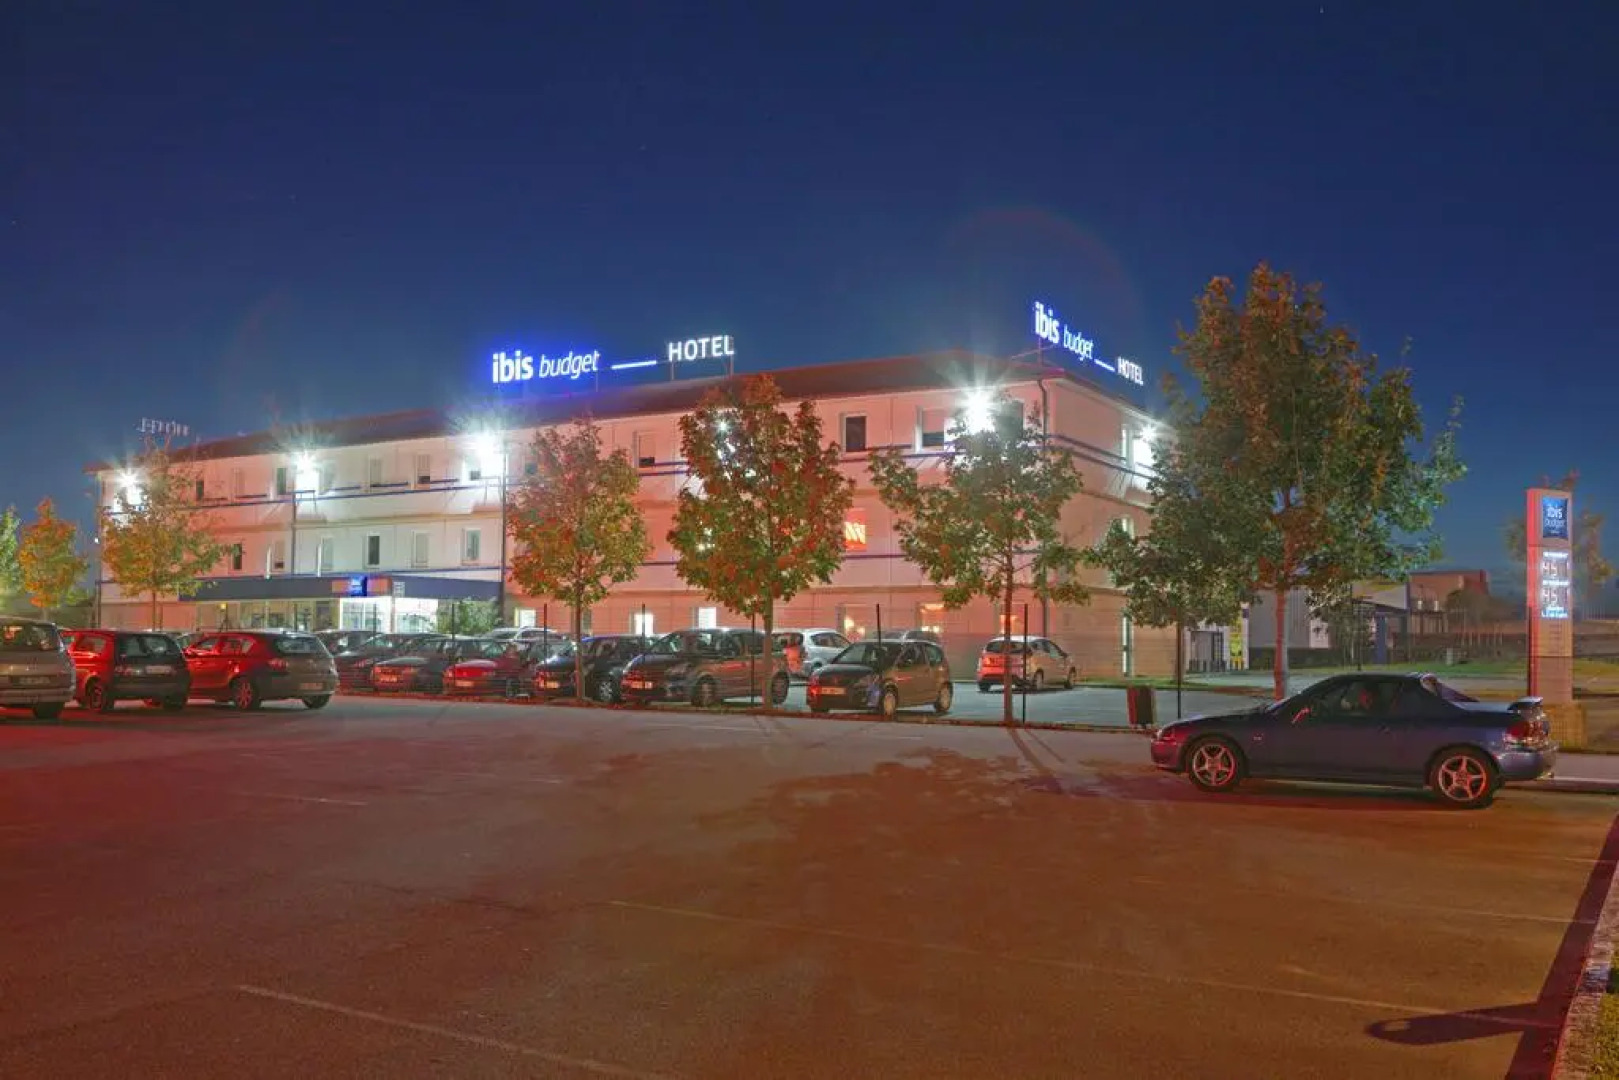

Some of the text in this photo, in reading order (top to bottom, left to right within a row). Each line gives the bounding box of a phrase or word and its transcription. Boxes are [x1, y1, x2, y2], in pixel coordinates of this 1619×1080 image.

[492, 334, 735, 384] ibis budget HOTEL
[1035, 301, 1144, 386] ibis budget HOTEL
